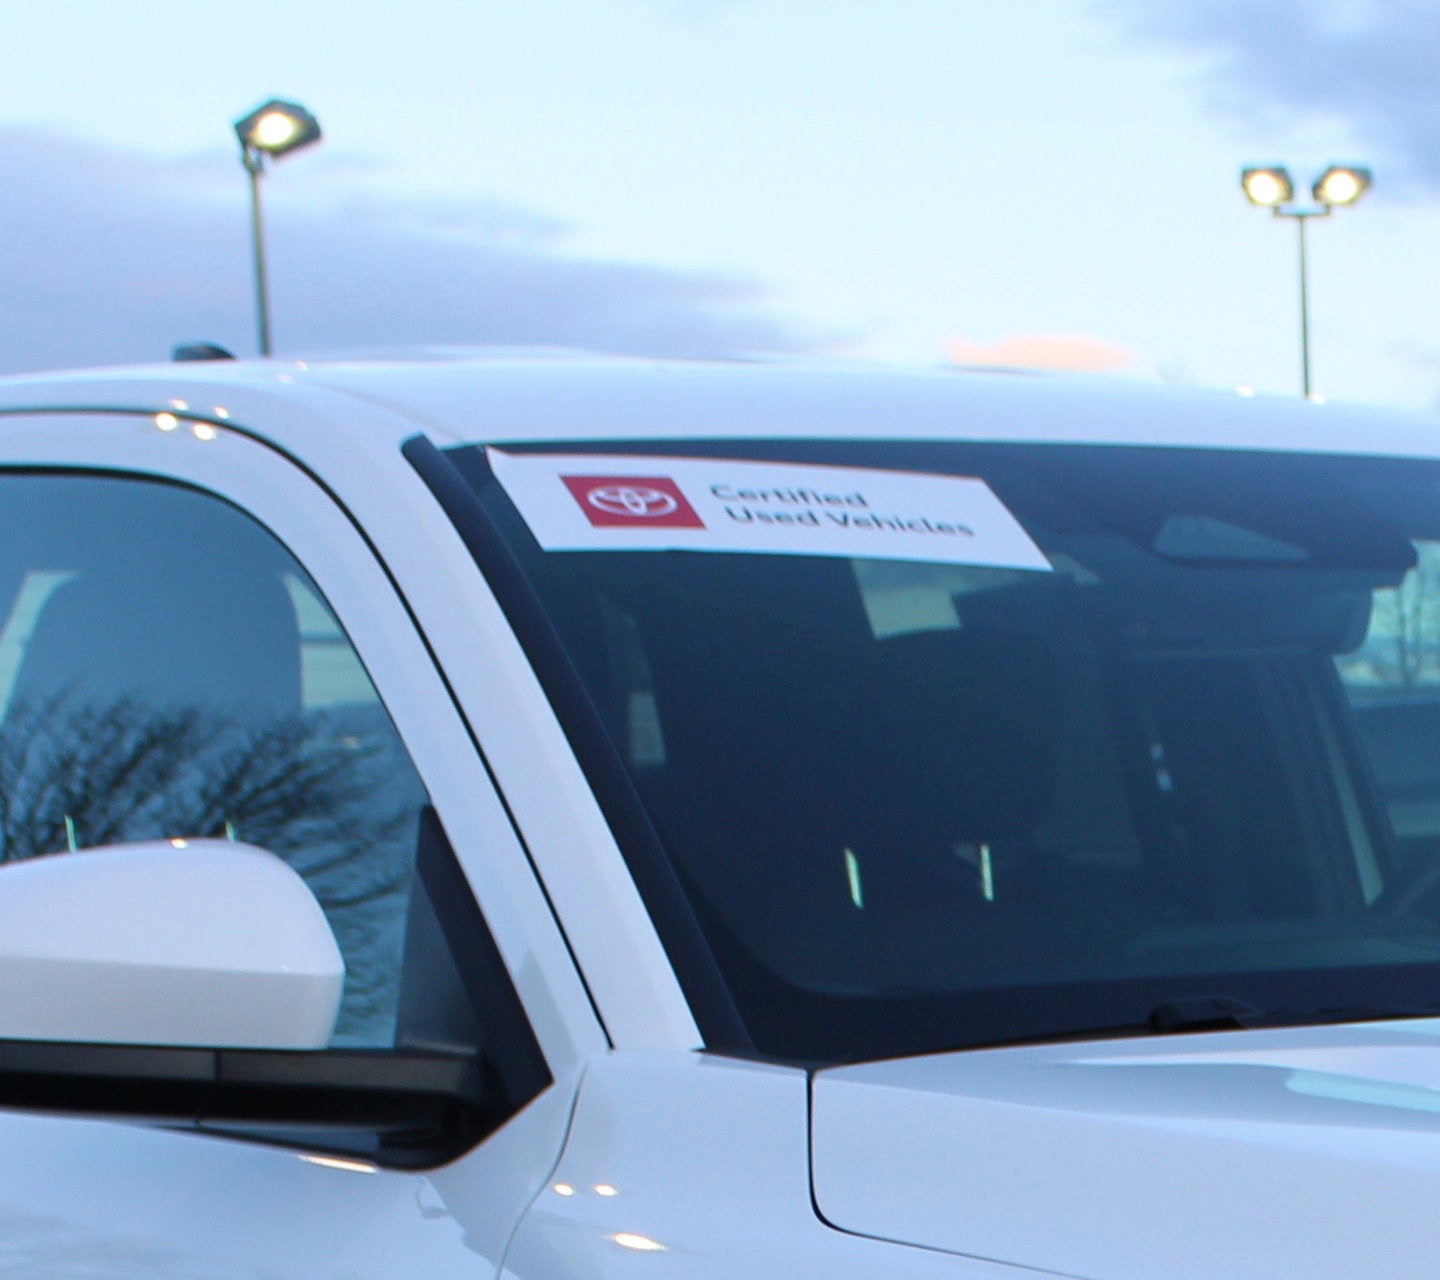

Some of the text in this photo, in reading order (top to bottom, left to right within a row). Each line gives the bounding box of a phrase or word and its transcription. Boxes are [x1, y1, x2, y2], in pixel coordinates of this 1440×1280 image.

[711, 484, 869, 508] Certified
[724, 505, 975, 537] Used Vehicles
